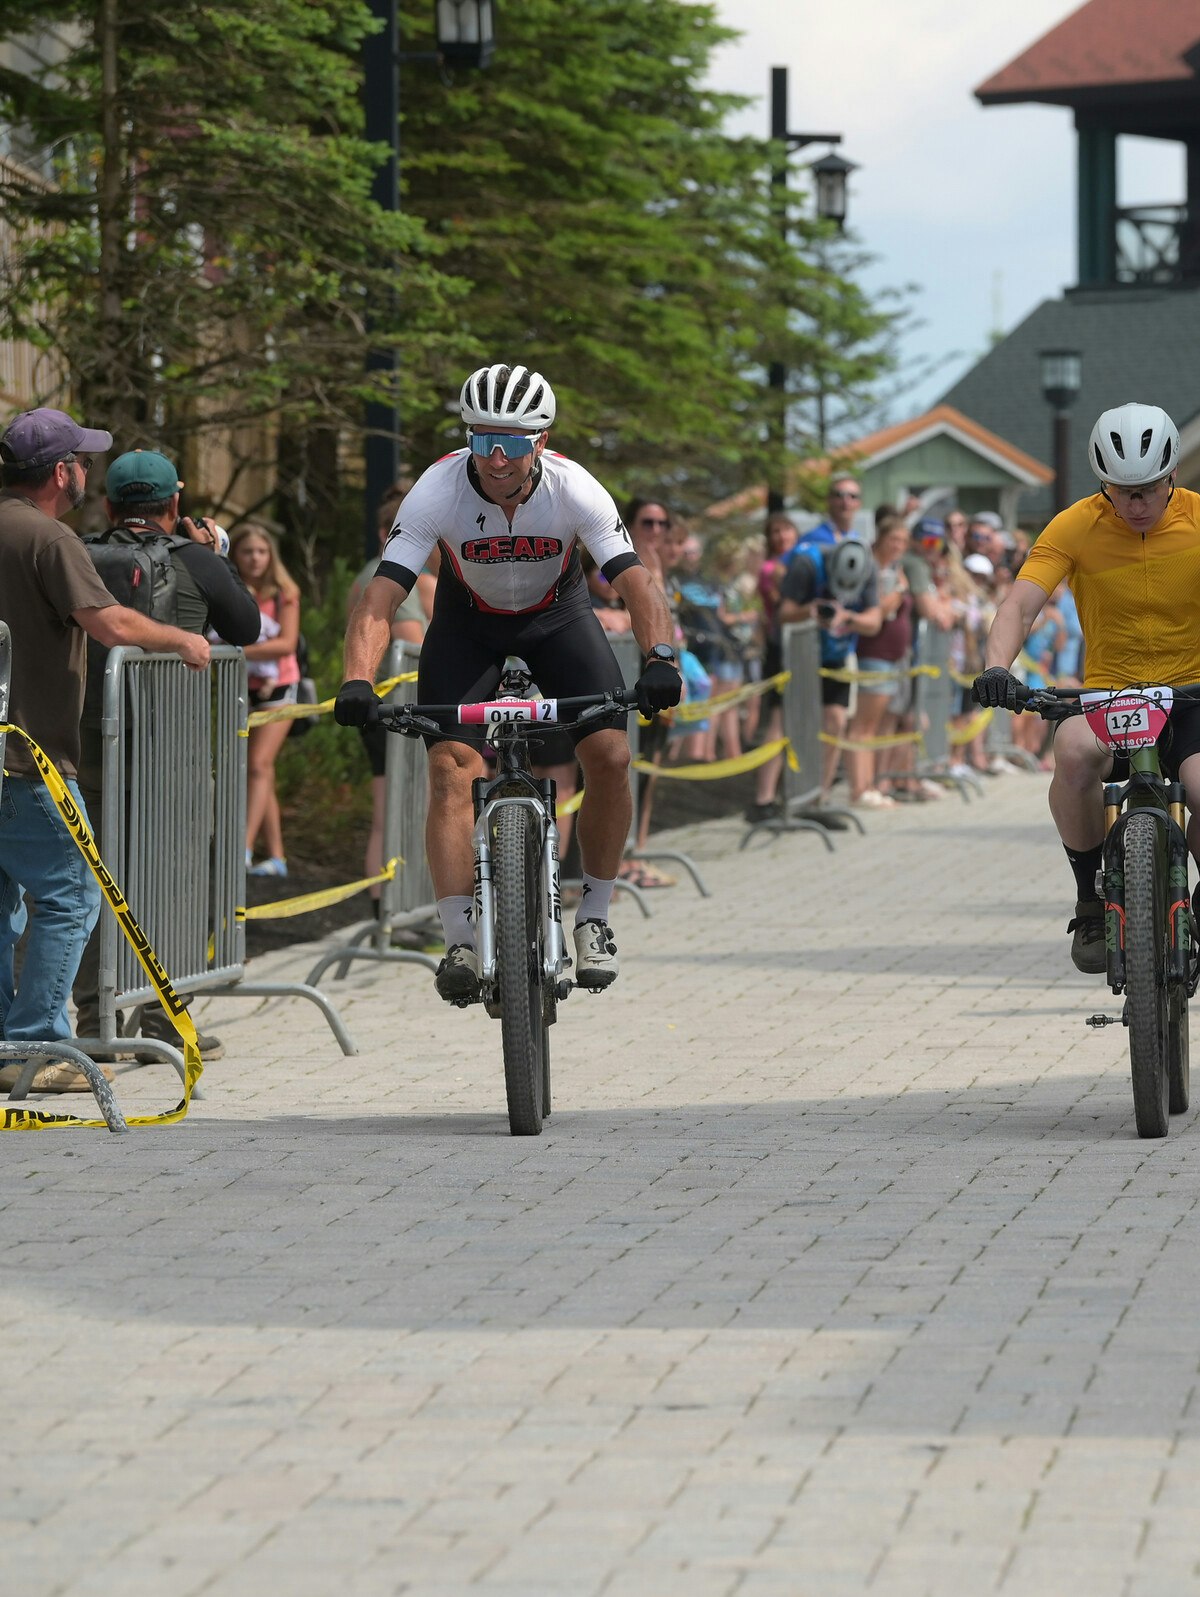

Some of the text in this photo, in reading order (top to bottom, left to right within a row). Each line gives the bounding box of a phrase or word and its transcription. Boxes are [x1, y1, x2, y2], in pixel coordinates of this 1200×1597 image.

[465, 537, 559, 559] GEAR
[490, 709, 525, 723] 016
[541, 703, 552, 721] 2
[1111, 712, 1143, 730] 123
